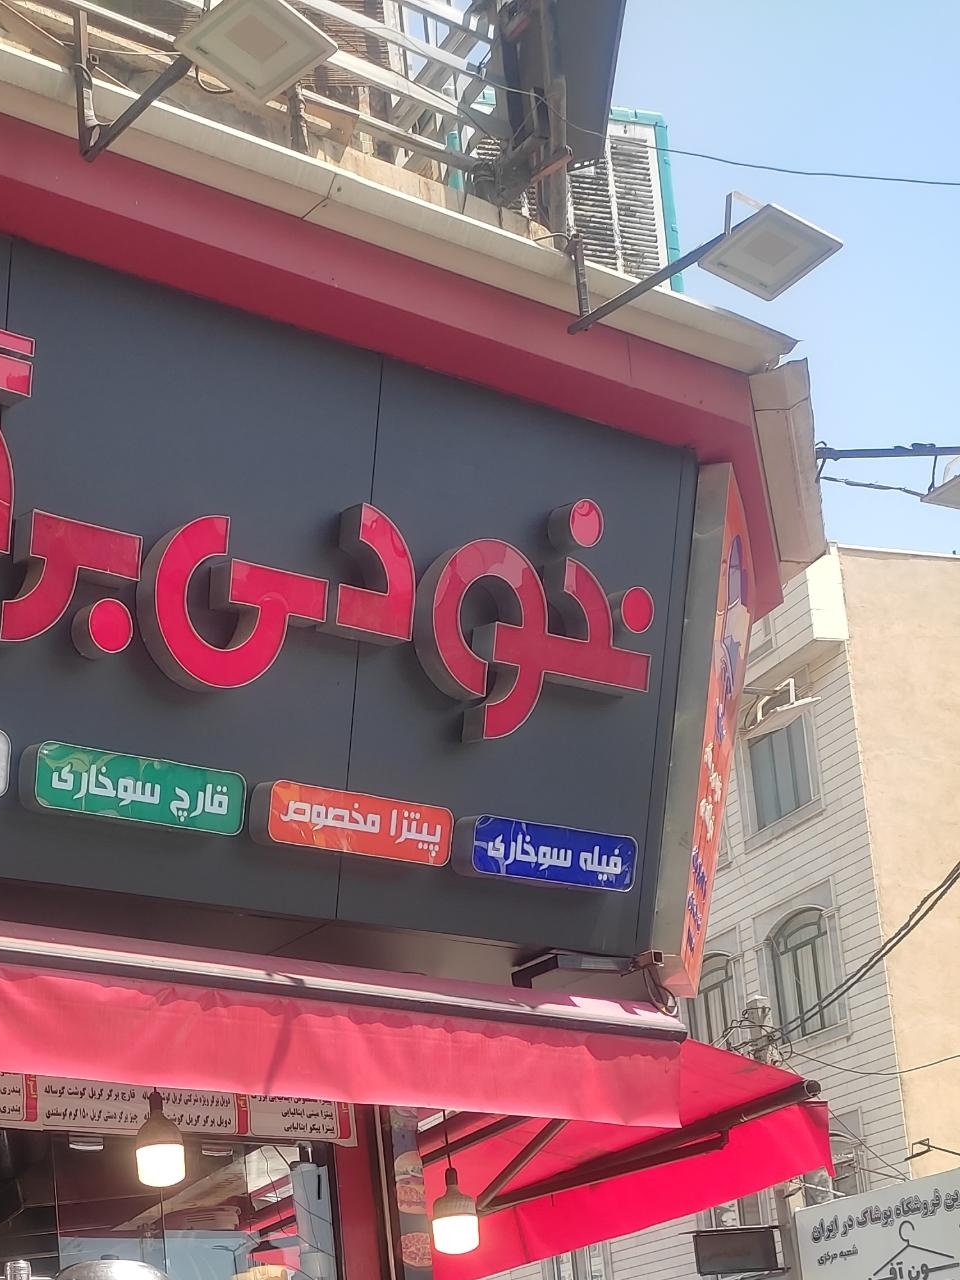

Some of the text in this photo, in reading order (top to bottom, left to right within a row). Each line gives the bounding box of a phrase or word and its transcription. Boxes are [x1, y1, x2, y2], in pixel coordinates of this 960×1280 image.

[145, 498, 654, 741] نخودی
[50, 762, 229, 823] قارچ سوخاری
[282, 797, 441, 857] پیتزا مخصوص
[487, 832, 624, 881] فیله سوخاری
[0, 1086, 21, 1096] بندری
[0, 1104, 21, 1115] بندری
[855, 1205, 893, 1227] پوشاک
[894, 1189, 942, 1218] فروشگاه
[811, 1215, 839, 1243] ایران
[840, 1215, 854, 1237] در
[817, 1244, 858, 1266] شعبه مرکزی
